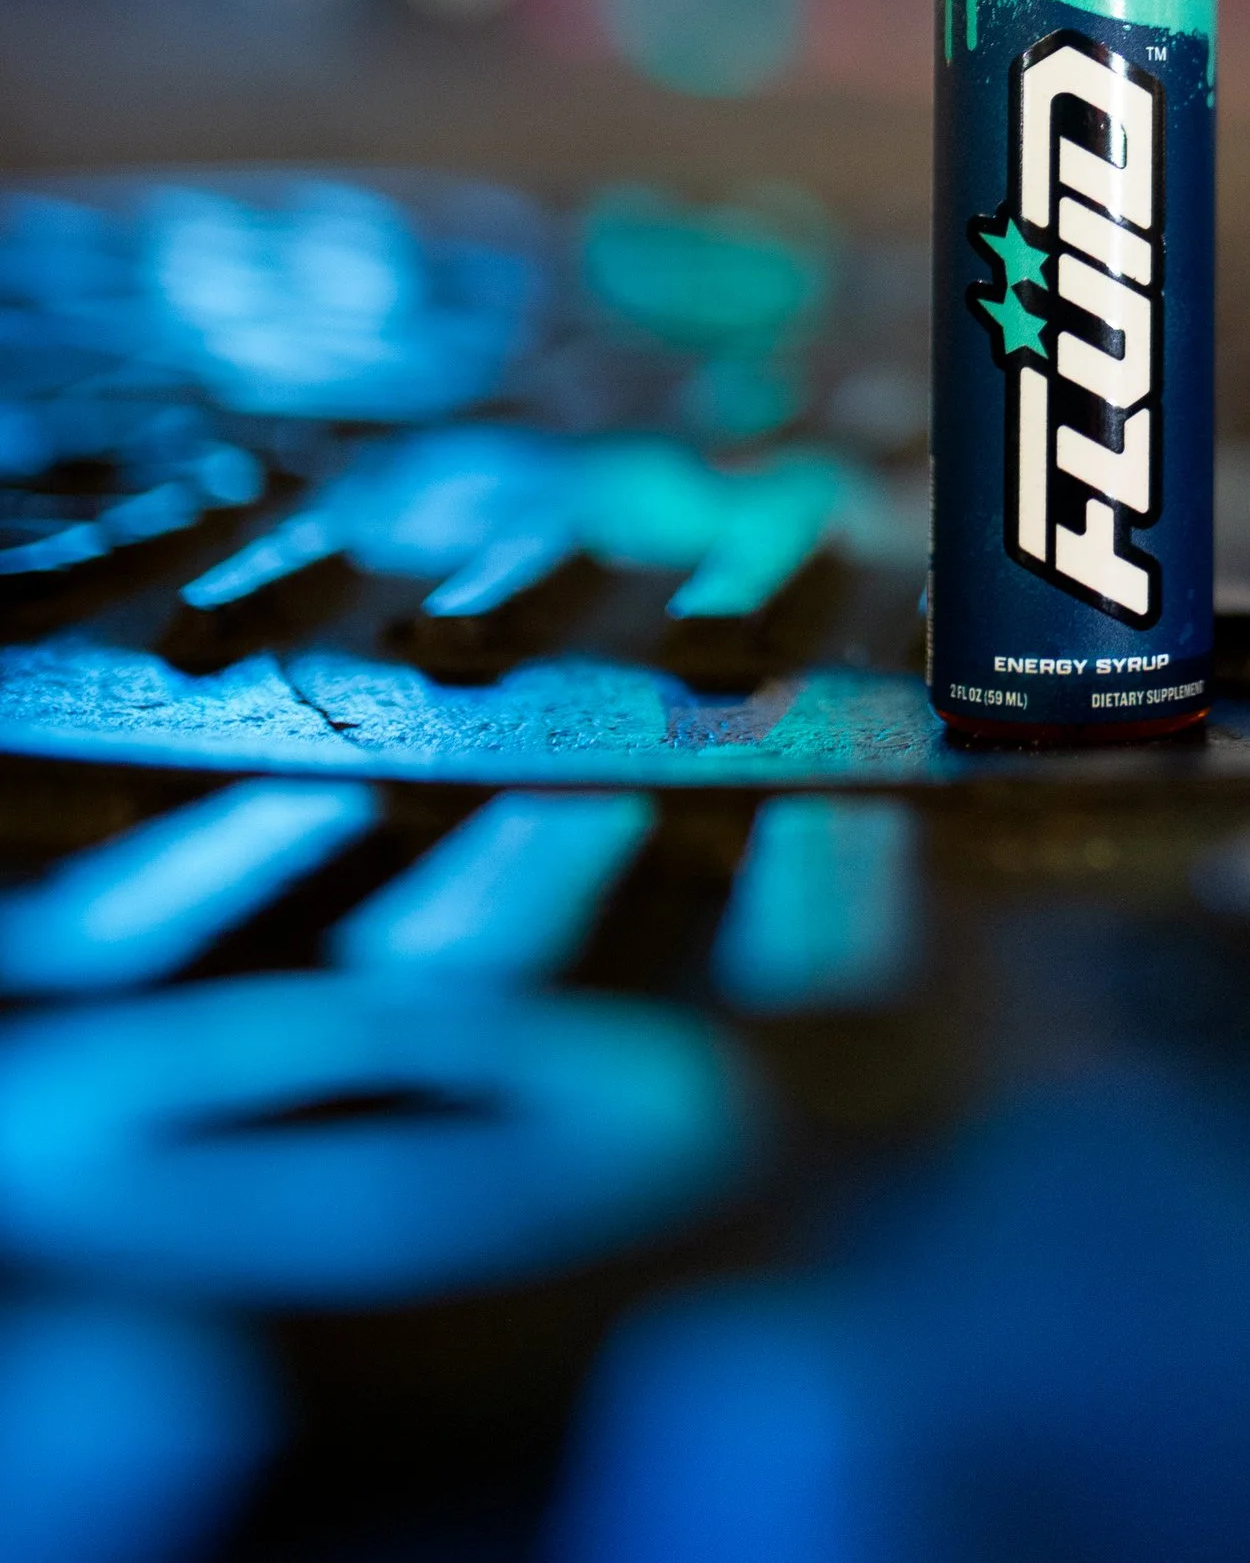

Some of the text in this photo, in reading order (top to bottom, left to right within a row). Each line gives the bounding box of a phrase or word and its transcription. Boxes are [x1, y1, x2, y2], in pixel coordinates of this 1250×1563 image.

[1146, 46, 1167, 62] TM
[1014, 40, 1157, 620] FLUID
[994, 653, 1170, 675] ENERGY SYRUP
[949, 683, 1028, 710] 2 FL OZ (59 ML)
[1091, 689, 1144, 708] DIETARY
